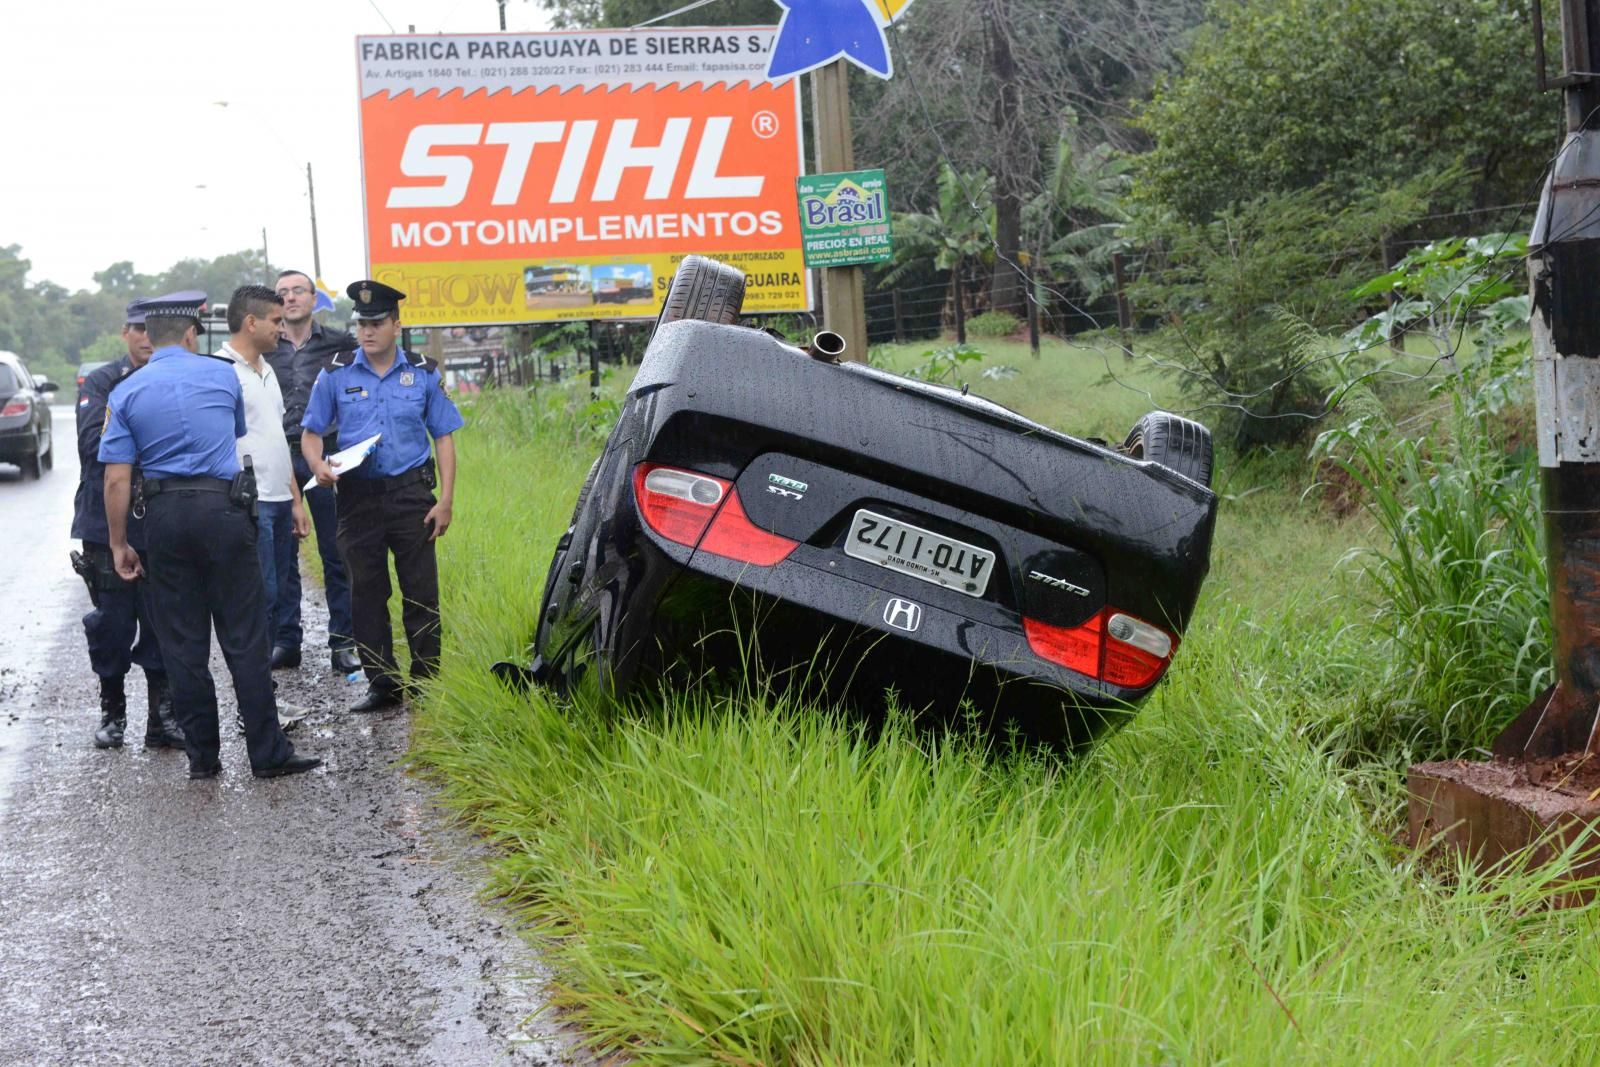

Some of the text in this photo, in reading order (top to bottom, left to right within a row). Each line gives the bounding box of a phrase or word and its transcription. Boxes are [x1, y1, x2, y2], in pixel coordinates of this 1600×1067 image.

[362, 41, 460, 61] FABRICA
[468, 38, 601, 59] PARAGUAYA
[609, 37, 638, 56] DE
[645, 36, 740, 55] SIERRAS
[385, 69, 424, 80] Artigas
[428, 68, 452, 78] 1840
[481, 66, 507, 78] (021)
[532, 65, 565, 76] 320/22
[569, 65, 591, 75] Fax:
[595, 63, 620, 76] (021)
[624, 64, 642, 73] 283
[645, 63, 664, 72] 444
[667, 62, 699, 72] Email:
[385, 116, 765, 208] STIHL
[805, 192, 883, 226] Brasil
[390, 210, 783, 248] MOTOIMPLEMENTOS
[807, 235, 889, 251] PRECIOS EN REAL
[732, 251, 785, 262] AUTORIZADO
[376, 267, 520, 309] SHOW
[745, 272, 801, 288] GUAIRA
[1028, 570, 1091, 598] CIVIC
